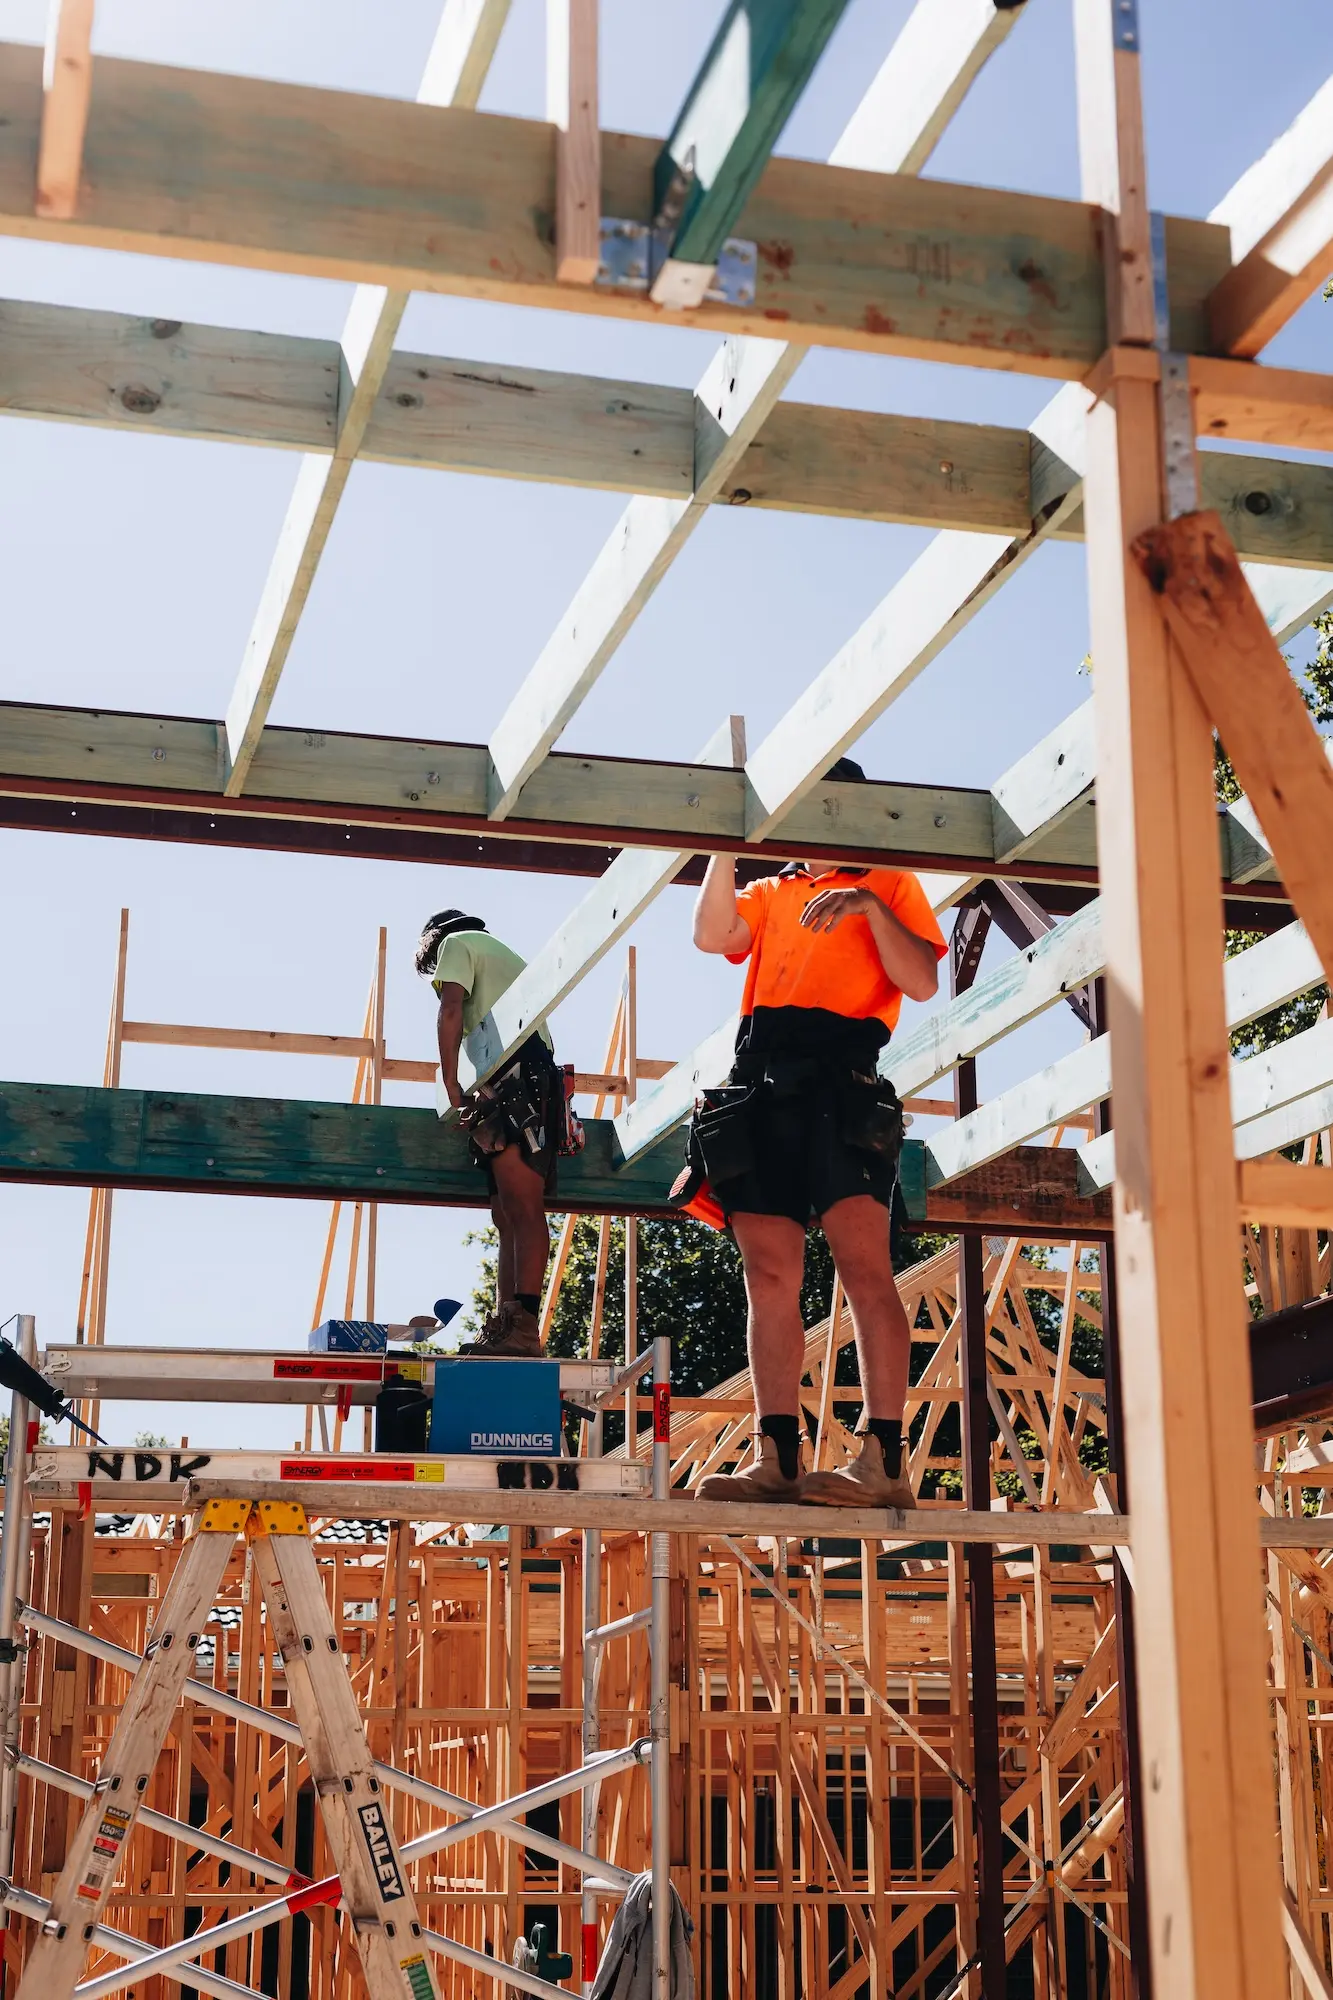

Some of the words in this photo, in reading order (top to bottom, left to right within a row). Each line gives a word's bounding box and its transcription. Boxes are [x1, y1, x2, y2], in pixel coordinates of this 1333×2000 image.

[277, 1364, 314, 1374] SYNERGY
[88, 1450, 211, 1482] NDK
[284, 1466, 325, 1475] SYNERGY
[107, 1808, 129, 1819] BAILEY
[361, 1805, 402, 1896] BAILEY
